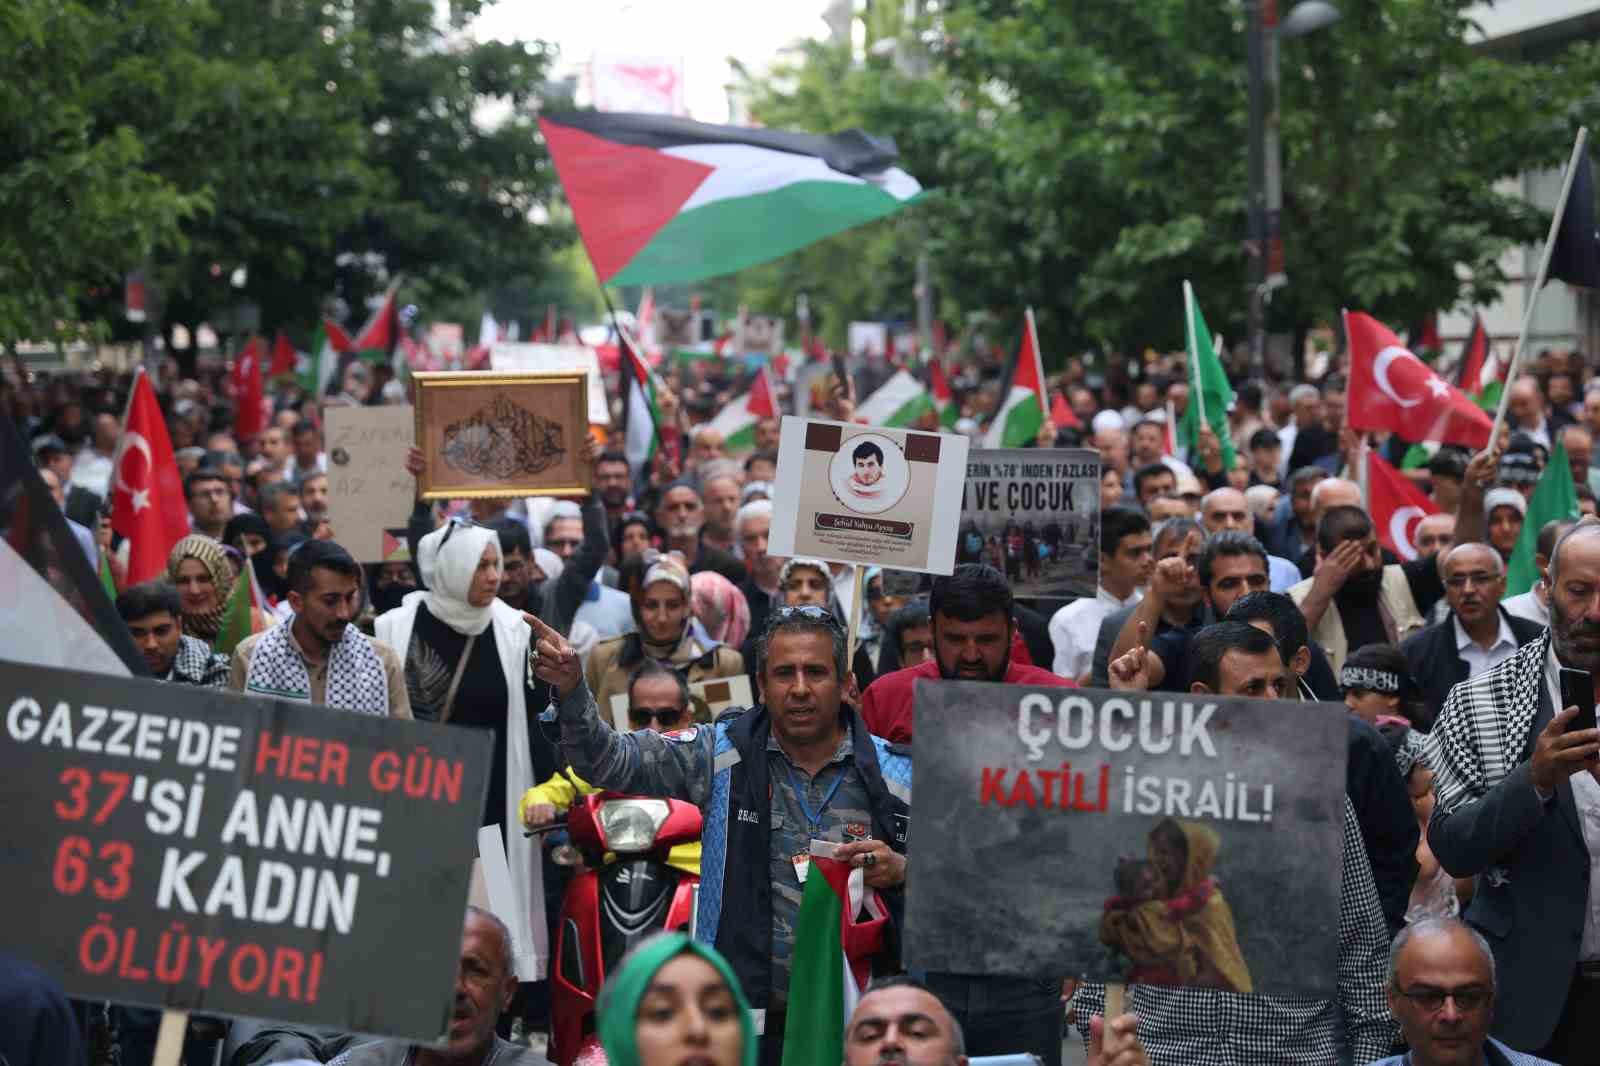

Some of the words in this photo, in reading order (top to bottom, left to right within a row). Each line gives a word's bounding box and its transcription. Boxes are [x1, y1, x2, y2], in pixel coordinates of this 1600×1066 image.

[975, 481, 999, 511] VE
[1007, 481, 1074, 516] ÇOCUK
[1056, 463, 1098, 478] FAZLASI
[7, 698, 241, 770] GAZZE'DE
[255, 730, 350, 786] HER
[369, 747, 464, 802] GÜN
[1018, 694, 1218, 760] ÇOCUK
[54, 768, 205, 839] 37'Sİ
[221, 789, 392, 877] ANNE,
[980, 762, 1110, 813] KATİLİ
[1124, 767, 1273, 823] İSRAİL!
[53, 835, 134, 900] 63
[156, 848, 361, 934] KADIN
[79, 914, 324, 1002] ÖLÜYOR!
